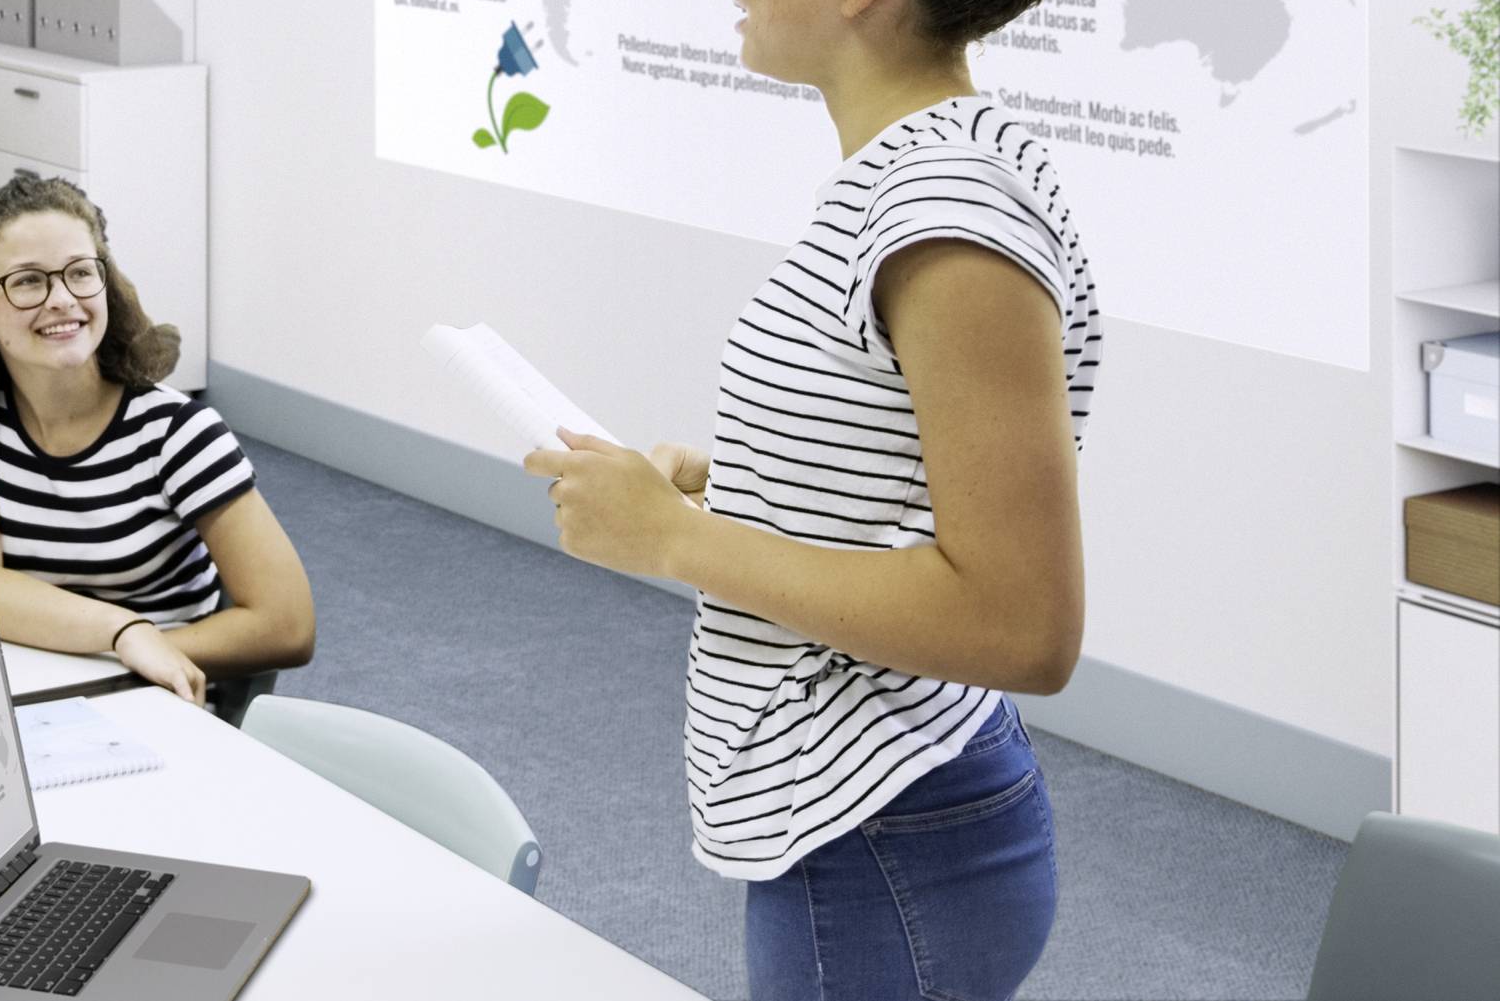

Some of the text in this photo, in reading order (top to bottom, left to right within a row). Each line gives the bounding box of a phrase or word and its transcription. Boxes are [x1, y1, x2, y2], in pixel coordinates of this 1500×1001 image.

[1028, 10, 1040, 26] at
[1044, 8, 1078, 31] lacus
[1080, 18, 1097, 33] ac
[618, 34, 679, 59] Pellentesque
[1011, 30, 1062, 54] lobortis.
[1024, 91, 1086, 119] hendrerit.
[1089, 101, 1126, 126] Morbi
[1129, 111, 1146, 128] ac
[1148, 110, 1181, 134] felis.
[1054, 122, 1082, 144] velit
[1085, 126, 1106, 148] leo
[1107, 132, 1136, 154] quis
[1138, 136, 1176, 159] pede.
